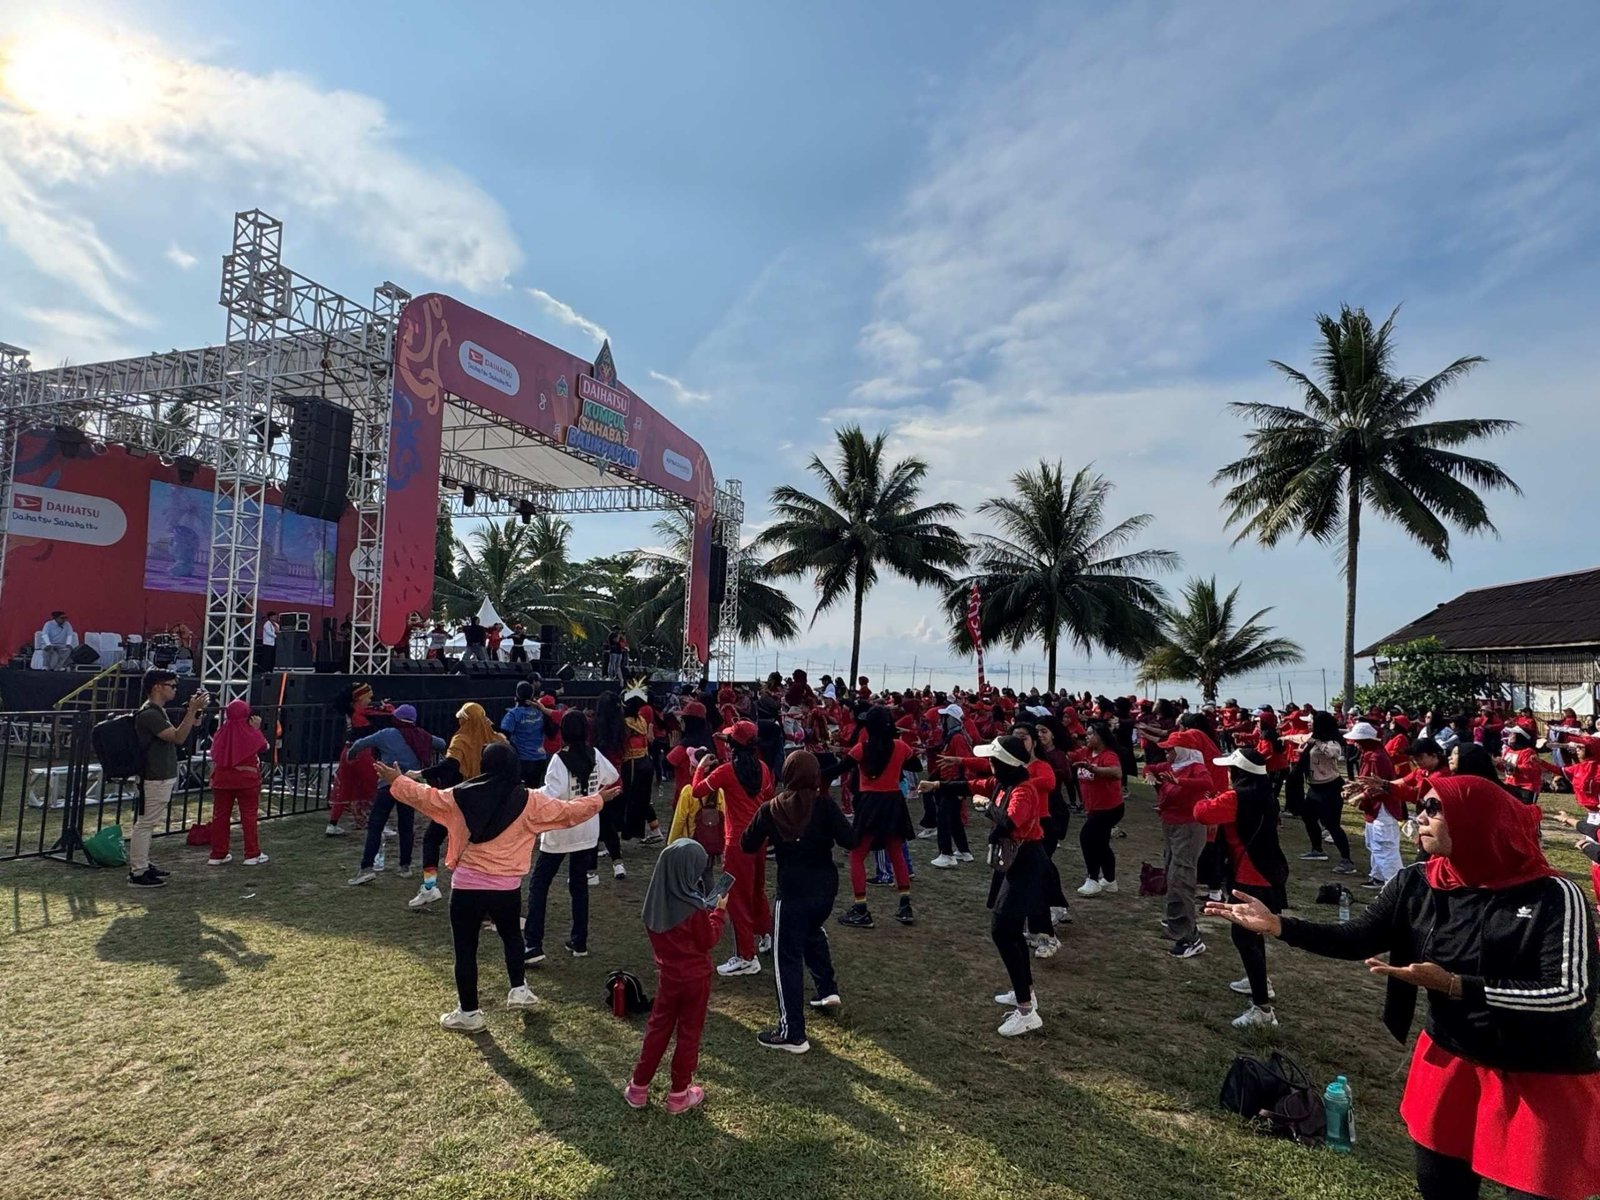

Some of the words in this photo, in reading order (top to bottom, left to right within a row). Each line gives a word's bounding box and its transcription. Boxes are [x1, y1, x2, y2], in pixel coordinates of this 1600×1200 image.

[583, 380, 627, 412] DAIHATSU
[584, 401, 625, 430] KUMPUL
[580, 418, 629, 446] SAHABAT
[569, 427, 637, 468] BALIKPAPAN
[12, 511, 52, 523] Daihatsu
[46, 502, 100, 518] DAIHATSU
